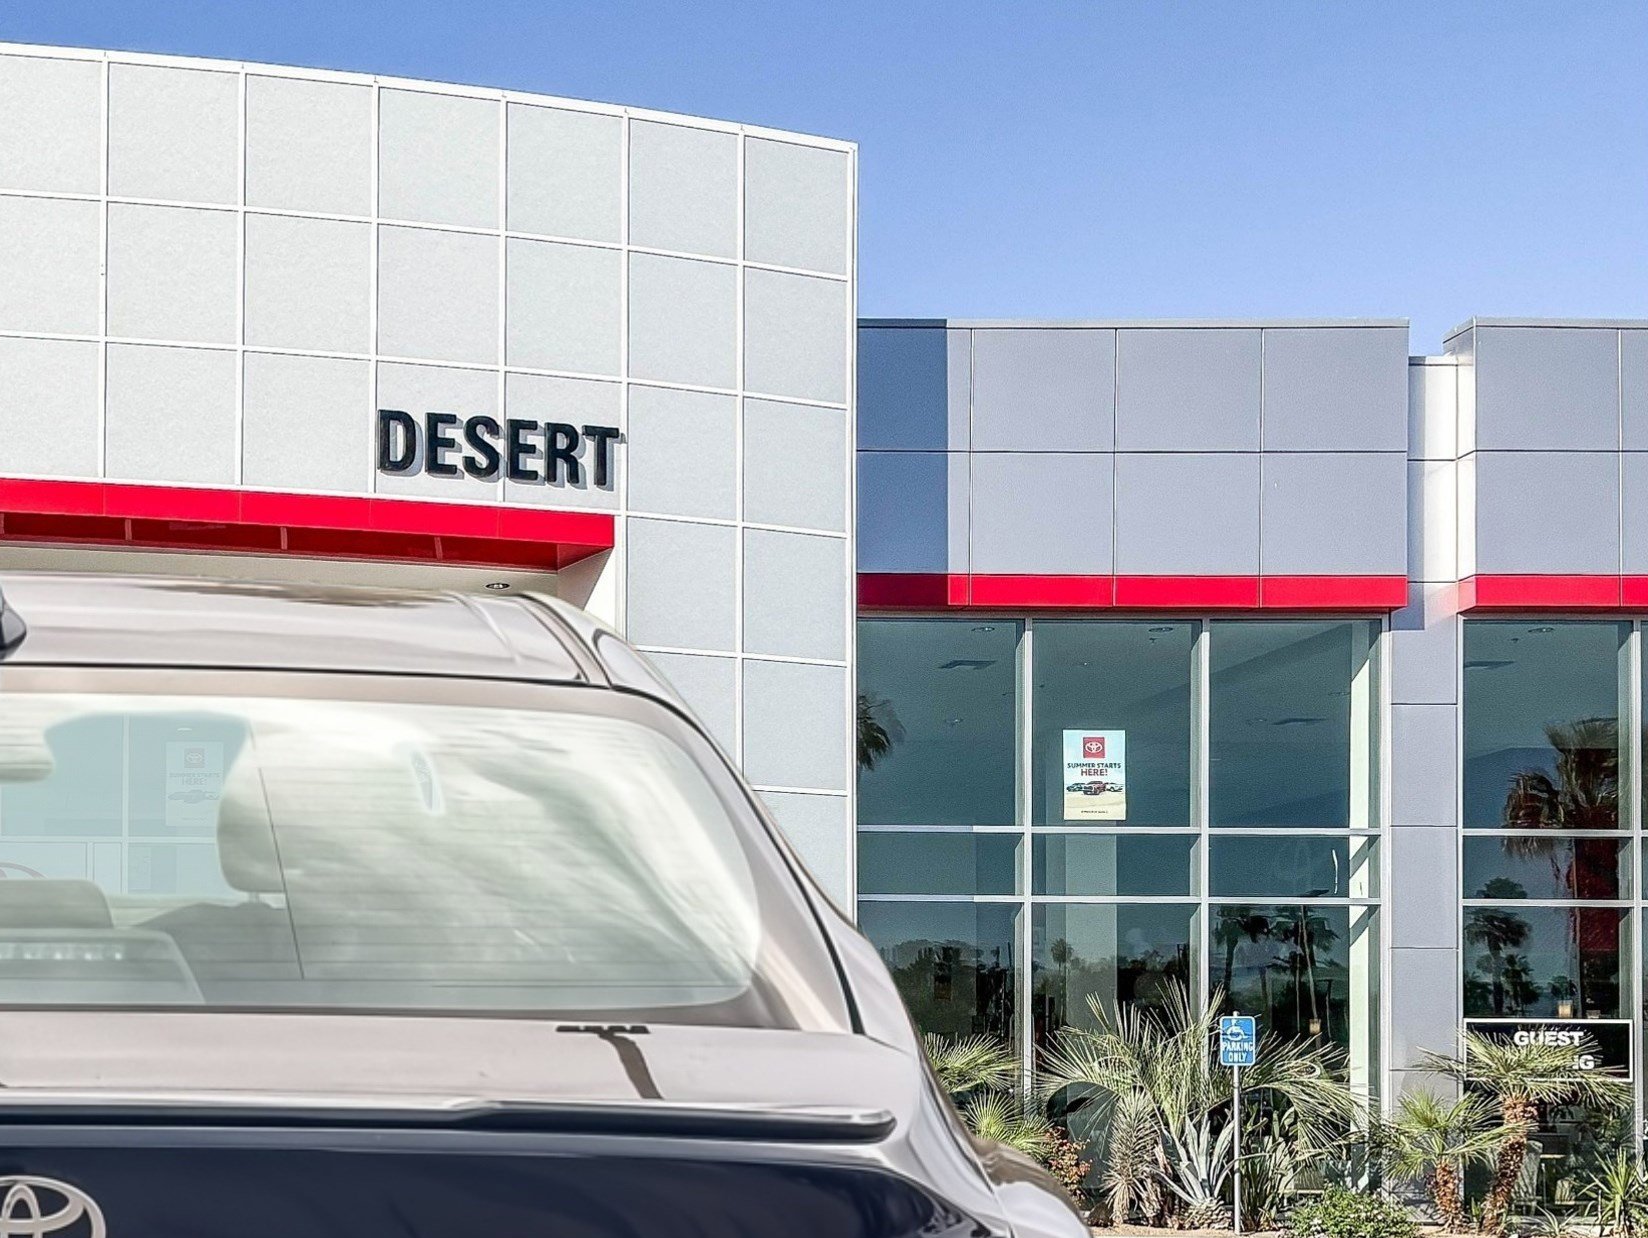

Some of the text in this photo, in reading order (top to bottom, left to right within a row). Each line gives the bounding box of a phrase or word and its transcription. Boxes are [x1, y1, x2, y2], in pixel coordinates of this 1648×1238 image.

[377, 409, 620, 487] DESERT
[1513, 1031, 1585, 1046] GUEST
[1222, 1042, 1253, 1052] PARKING
[1228, 1052, 1248, 1062] ONLY
